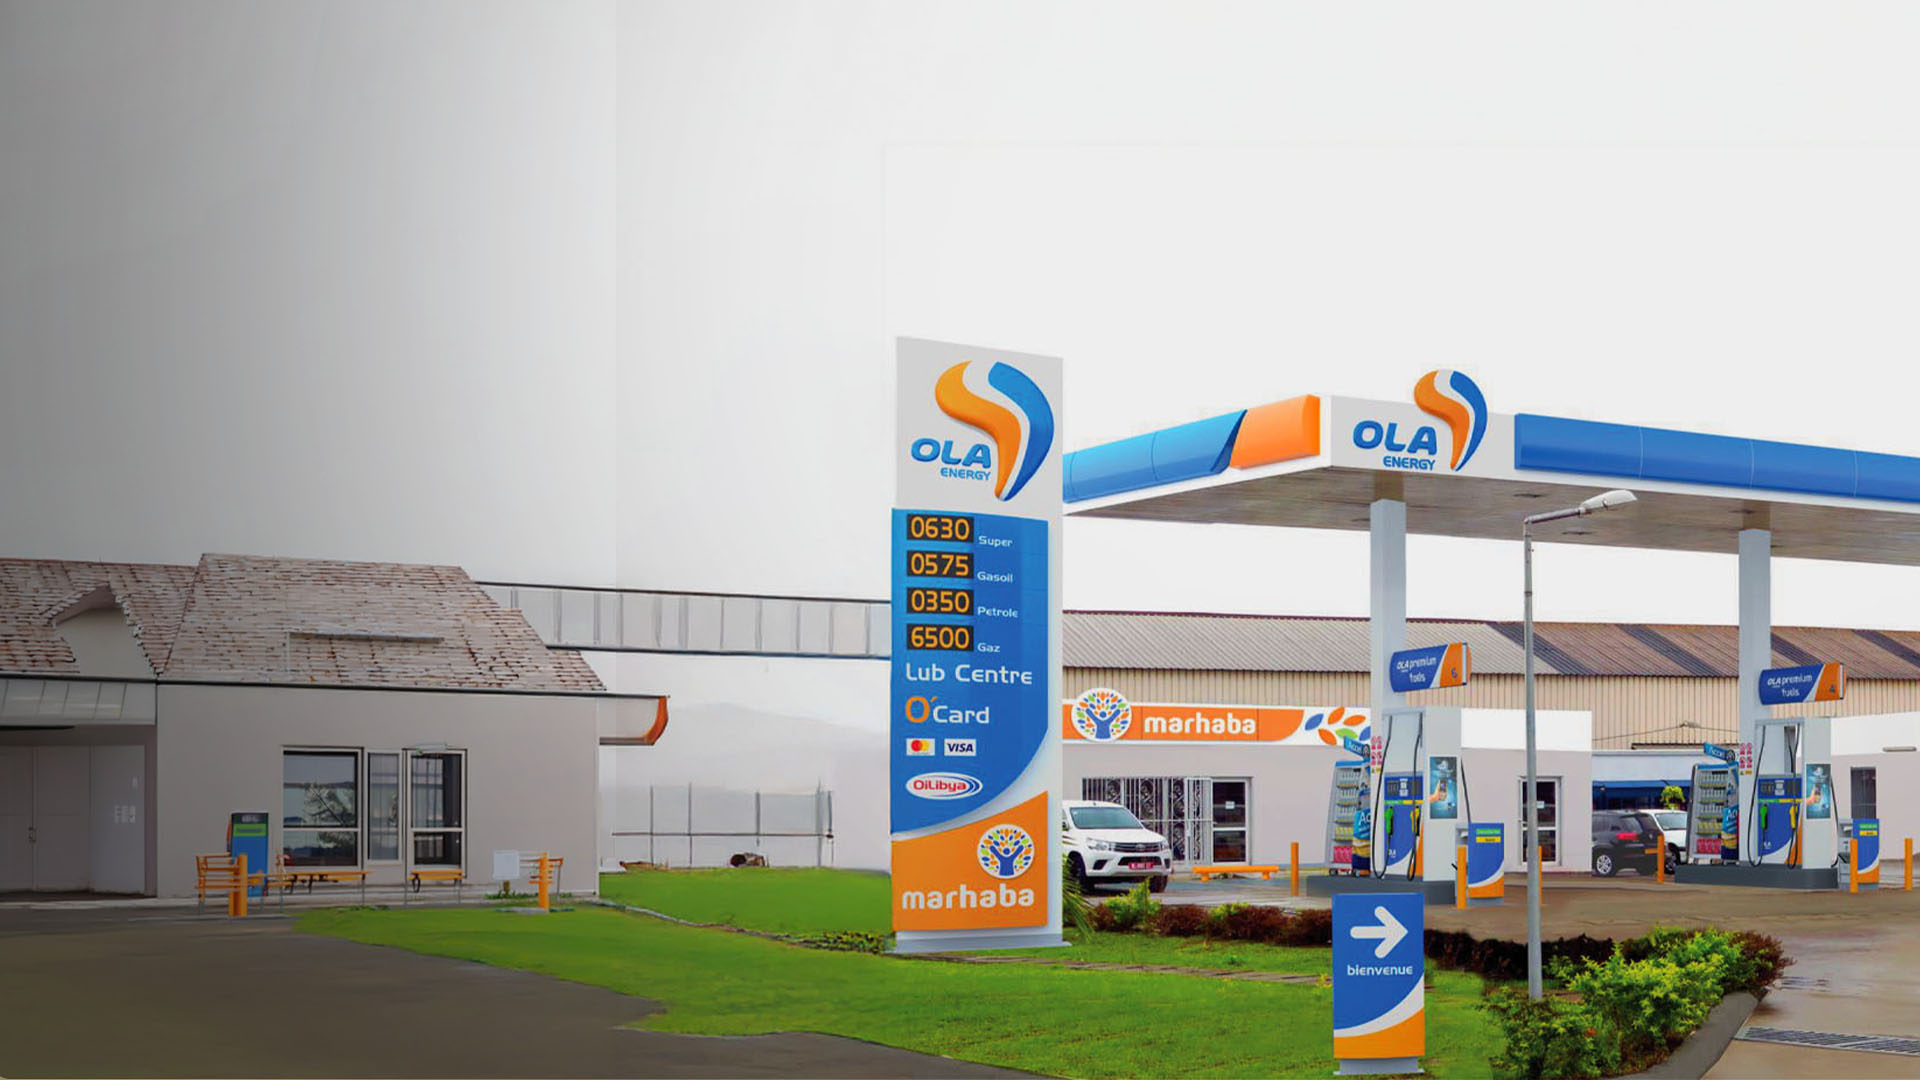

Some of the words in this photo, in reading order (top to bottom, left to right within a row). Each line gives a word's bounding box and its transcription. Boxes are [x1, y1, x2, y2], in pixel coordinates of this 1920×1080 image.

[1353, 420, 1437, 455] OLA
[911, 438, 992, 469] OLA
[1383, 455, 1436, 470] ENERGY
[940, 467, 991, 481] ENERGY
[911, 516, 970, 540] 0630
[978, 535, 1013, 547] Super
[911, 552, 969, 576] 0575
[977, 571, 1013, 583] Gasoil
[911, 589, 970, 613] 0350
[977, 606, 1018, 618] Petrole
[911, 626, 969, 649] 6500
[977, 643, 1001, 653] Gaz
[906, 663, 946, 681] Lub
[955, 664, 1032, 685] Centre
[1782, 673, 1813, 687] premium
[1144, 712, 1256, 734] marhaba
[947, 743, 974, 753] VISA
[913, 780, 967, 792] OiLibya
[902, 883, 1035, 910] marhaba
[1347, 965, 1413, 976] bienvenue
